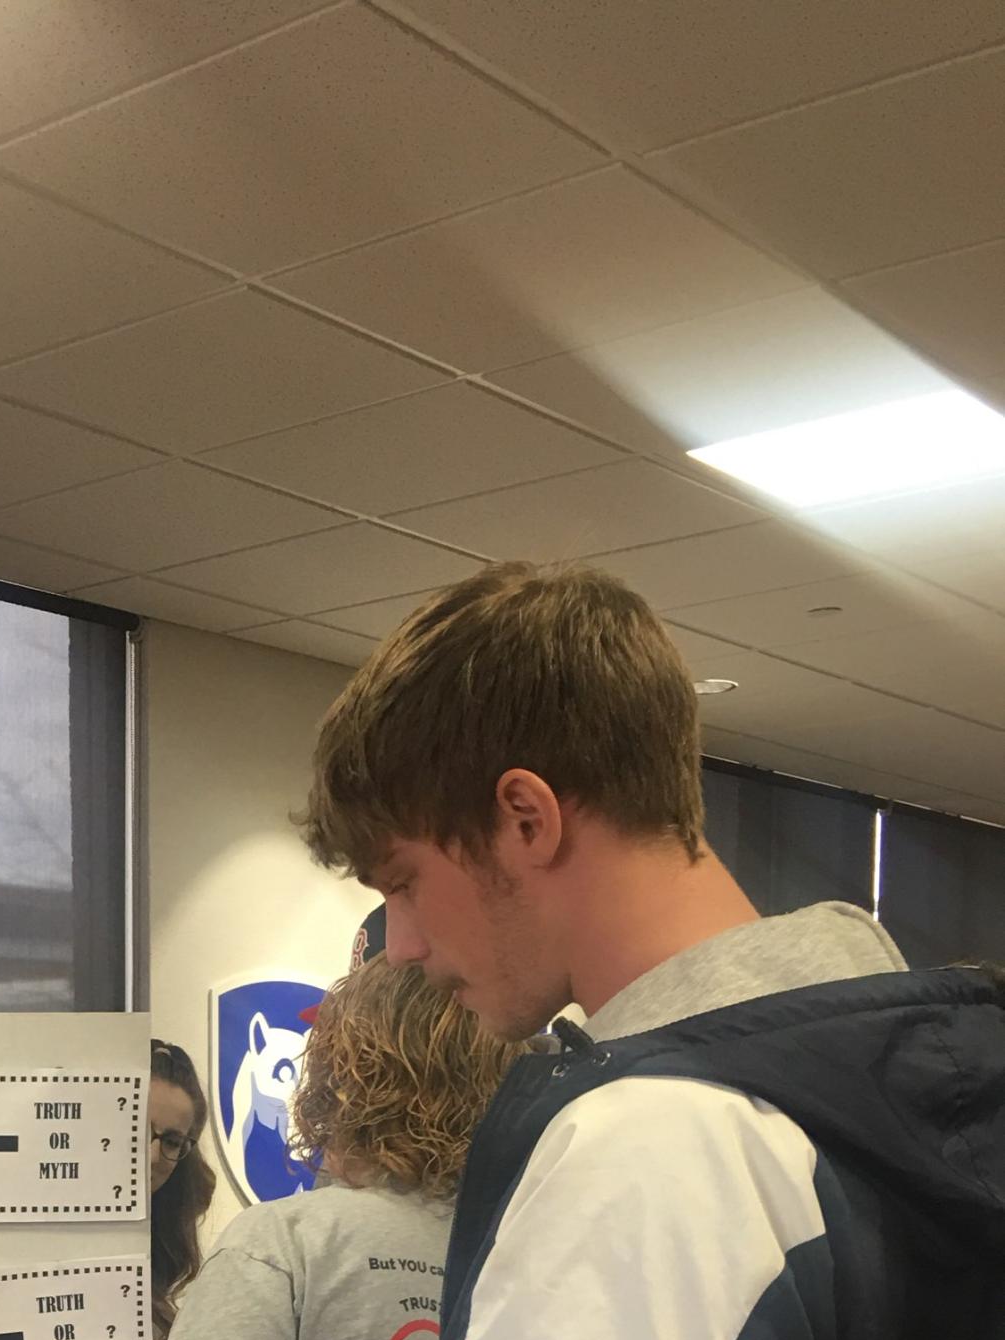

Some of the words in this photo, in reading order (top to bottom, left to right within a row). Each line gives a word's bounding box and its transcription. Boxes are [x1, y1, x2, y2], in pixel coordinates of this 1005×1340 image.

[34, 1102, 82, 1120] TRUTH
[49, 1132, 70, 1150] OR
[39, 1162, 79, 1179] MYTH
[368, 1257, 397, 1270] But
[398, 1258, 427, 1273] YOU
[429, 1265, 444, 1276] ca
[36, 1293, 85, 1314] TRUTH
[399, 1297, 442, 1312] TRUS
